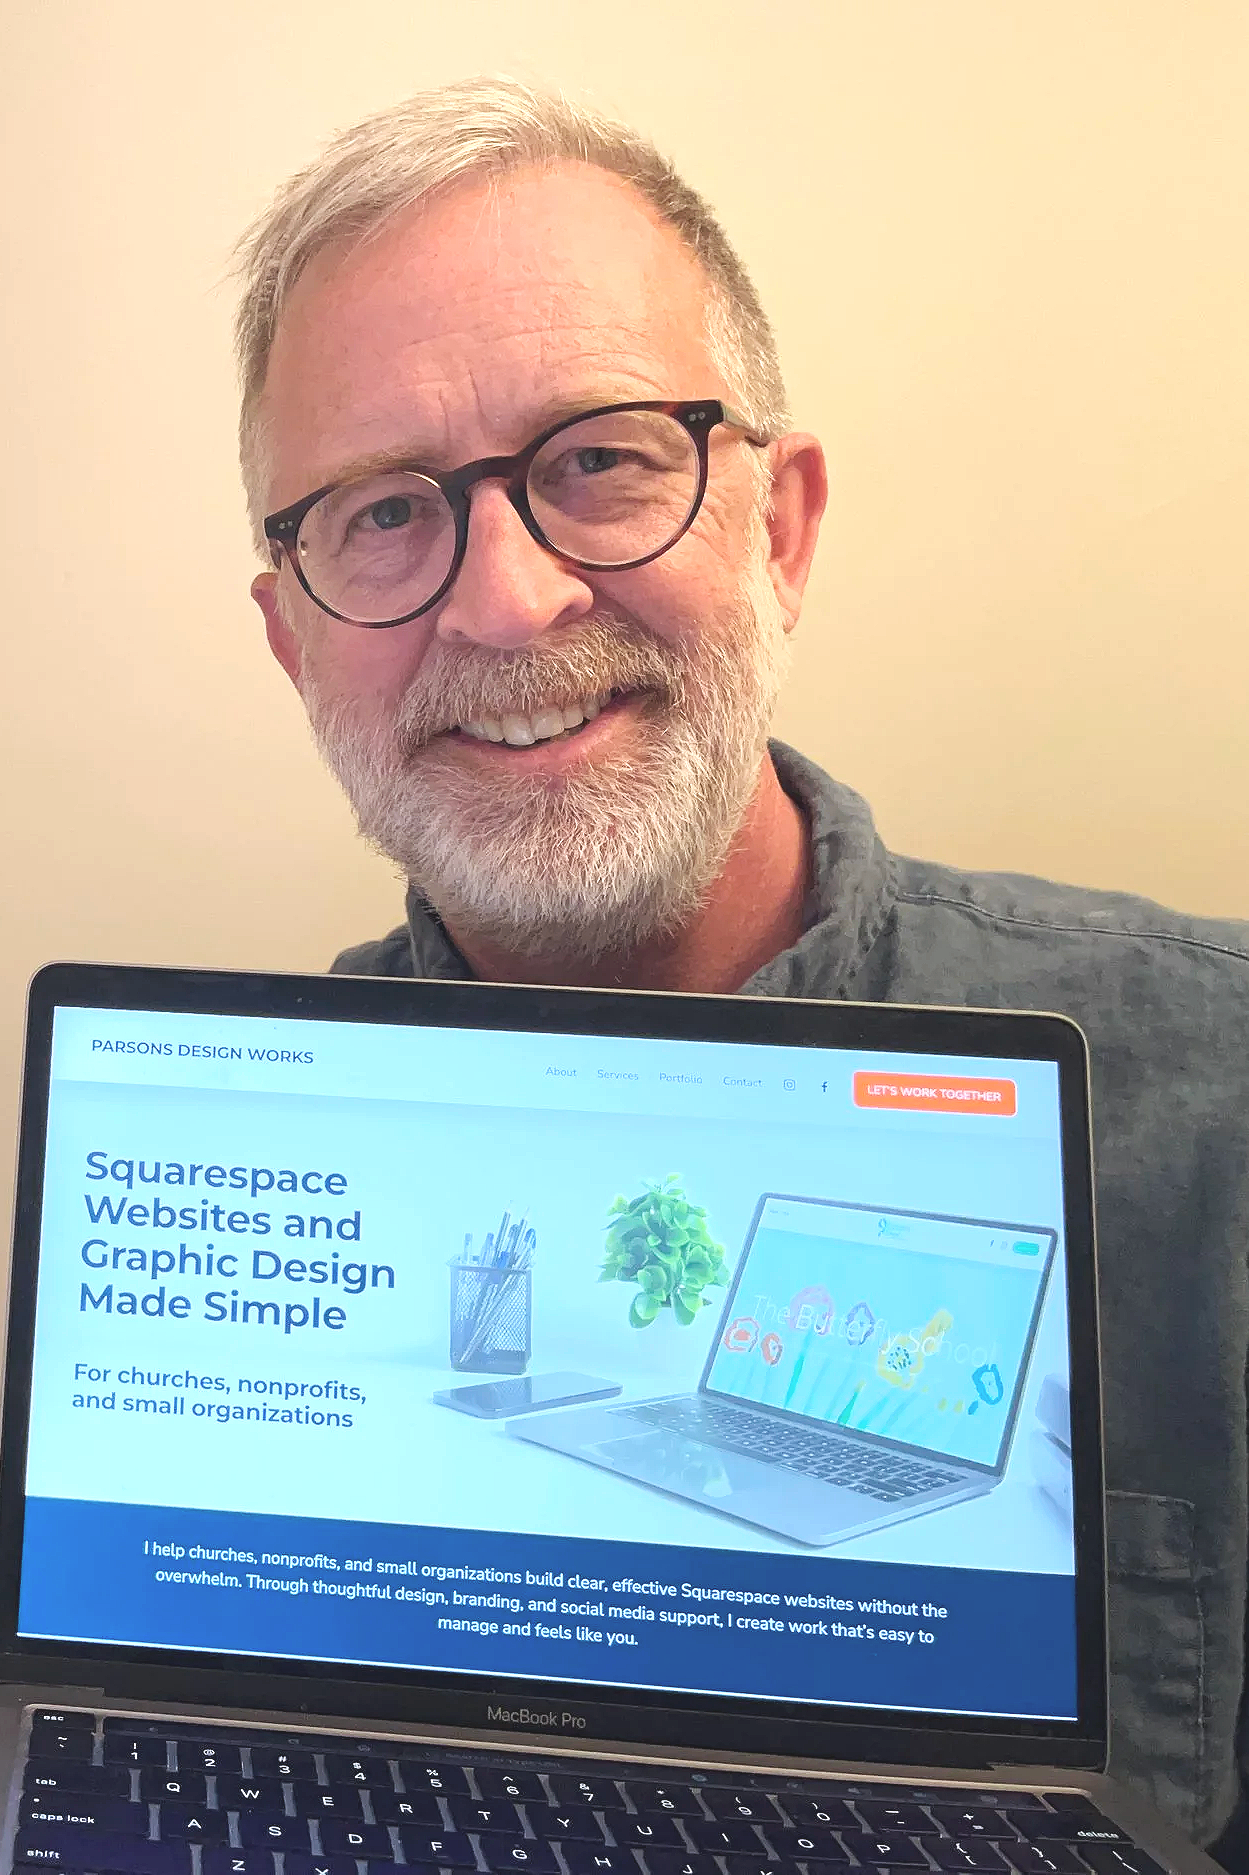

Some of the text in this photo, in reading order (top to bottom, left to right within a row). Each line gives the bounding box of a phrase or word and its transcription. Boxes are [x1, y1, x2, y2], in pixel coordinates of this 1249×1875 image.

[92, 1039, 314, 1064] PARSONS DESIGN WORKS
[545, 1066, 762, 1088] About Services Portfolio Contact
[867, 1084, 1002, 1102] LET'S WORK TOGETHER
[85, 1151, 349, 1198] Squarespace
[84, 1195, 362, 1242] Websites and
[81, 1239, 396, 1294] Graphic Design
[79, 1283, 348, 1335] Made Simple
[73, 1363, 367, 1404] For churches, nonprofits,
[72, 1392, 354, 1429] and small organizations
[144, 1541, 948, 1618] I help churches, nonprofits, and small organizations build clear, effective Squarespace websites without the
[155, 1569, 935, 1645] overwhelm. Through thoughtful design, branding, and social media support, I create work that's easy to
[438, 1616, 639, 1646] manage and feels like you.
[487, 1706, 587, 1729] MacBook Pro
[131, 1752, 139, 1760] 1
[204, 1758, 216, 1768] 2
[279, 1765, 291, 1774] 3
[35, 1777, 57, 1786] tab
[354, 1772, 367, 1781] 4
[166, 1782, 181, 1793] Q
[430, 1778, 443, 1788] 5
[240, 1788, 260, 1799] W
[506, 1786, 520, 1795] 6
[322, 1796, 334, 1806] E
[583, 1792, 594, 1802] 7
[399, 1803, 413, 1814] R
[661, 1799, 675, 1809] 8
[31, 1812, 95, 1824] caps lock
[477, 1810, 491, 1821] T
[187, 1819, 202, 1829] A
[556, 1817, 570, 1828] Y
[268, 1825, 282, 1836] S
[636, 1825, 653, 1836] U
[1076, 1830, 1120, 1839] delete
[348, 1833, 363, 1844] D
[431, 1841, 443, 1852] F
[876, 1844, 891, 1853] P
[26, 1849, 61, 1859] shift
[512, 1849, 528, 1860] G
[231, 1860, 246, 1871] Z
[594, 1856, 612, 1867] H
